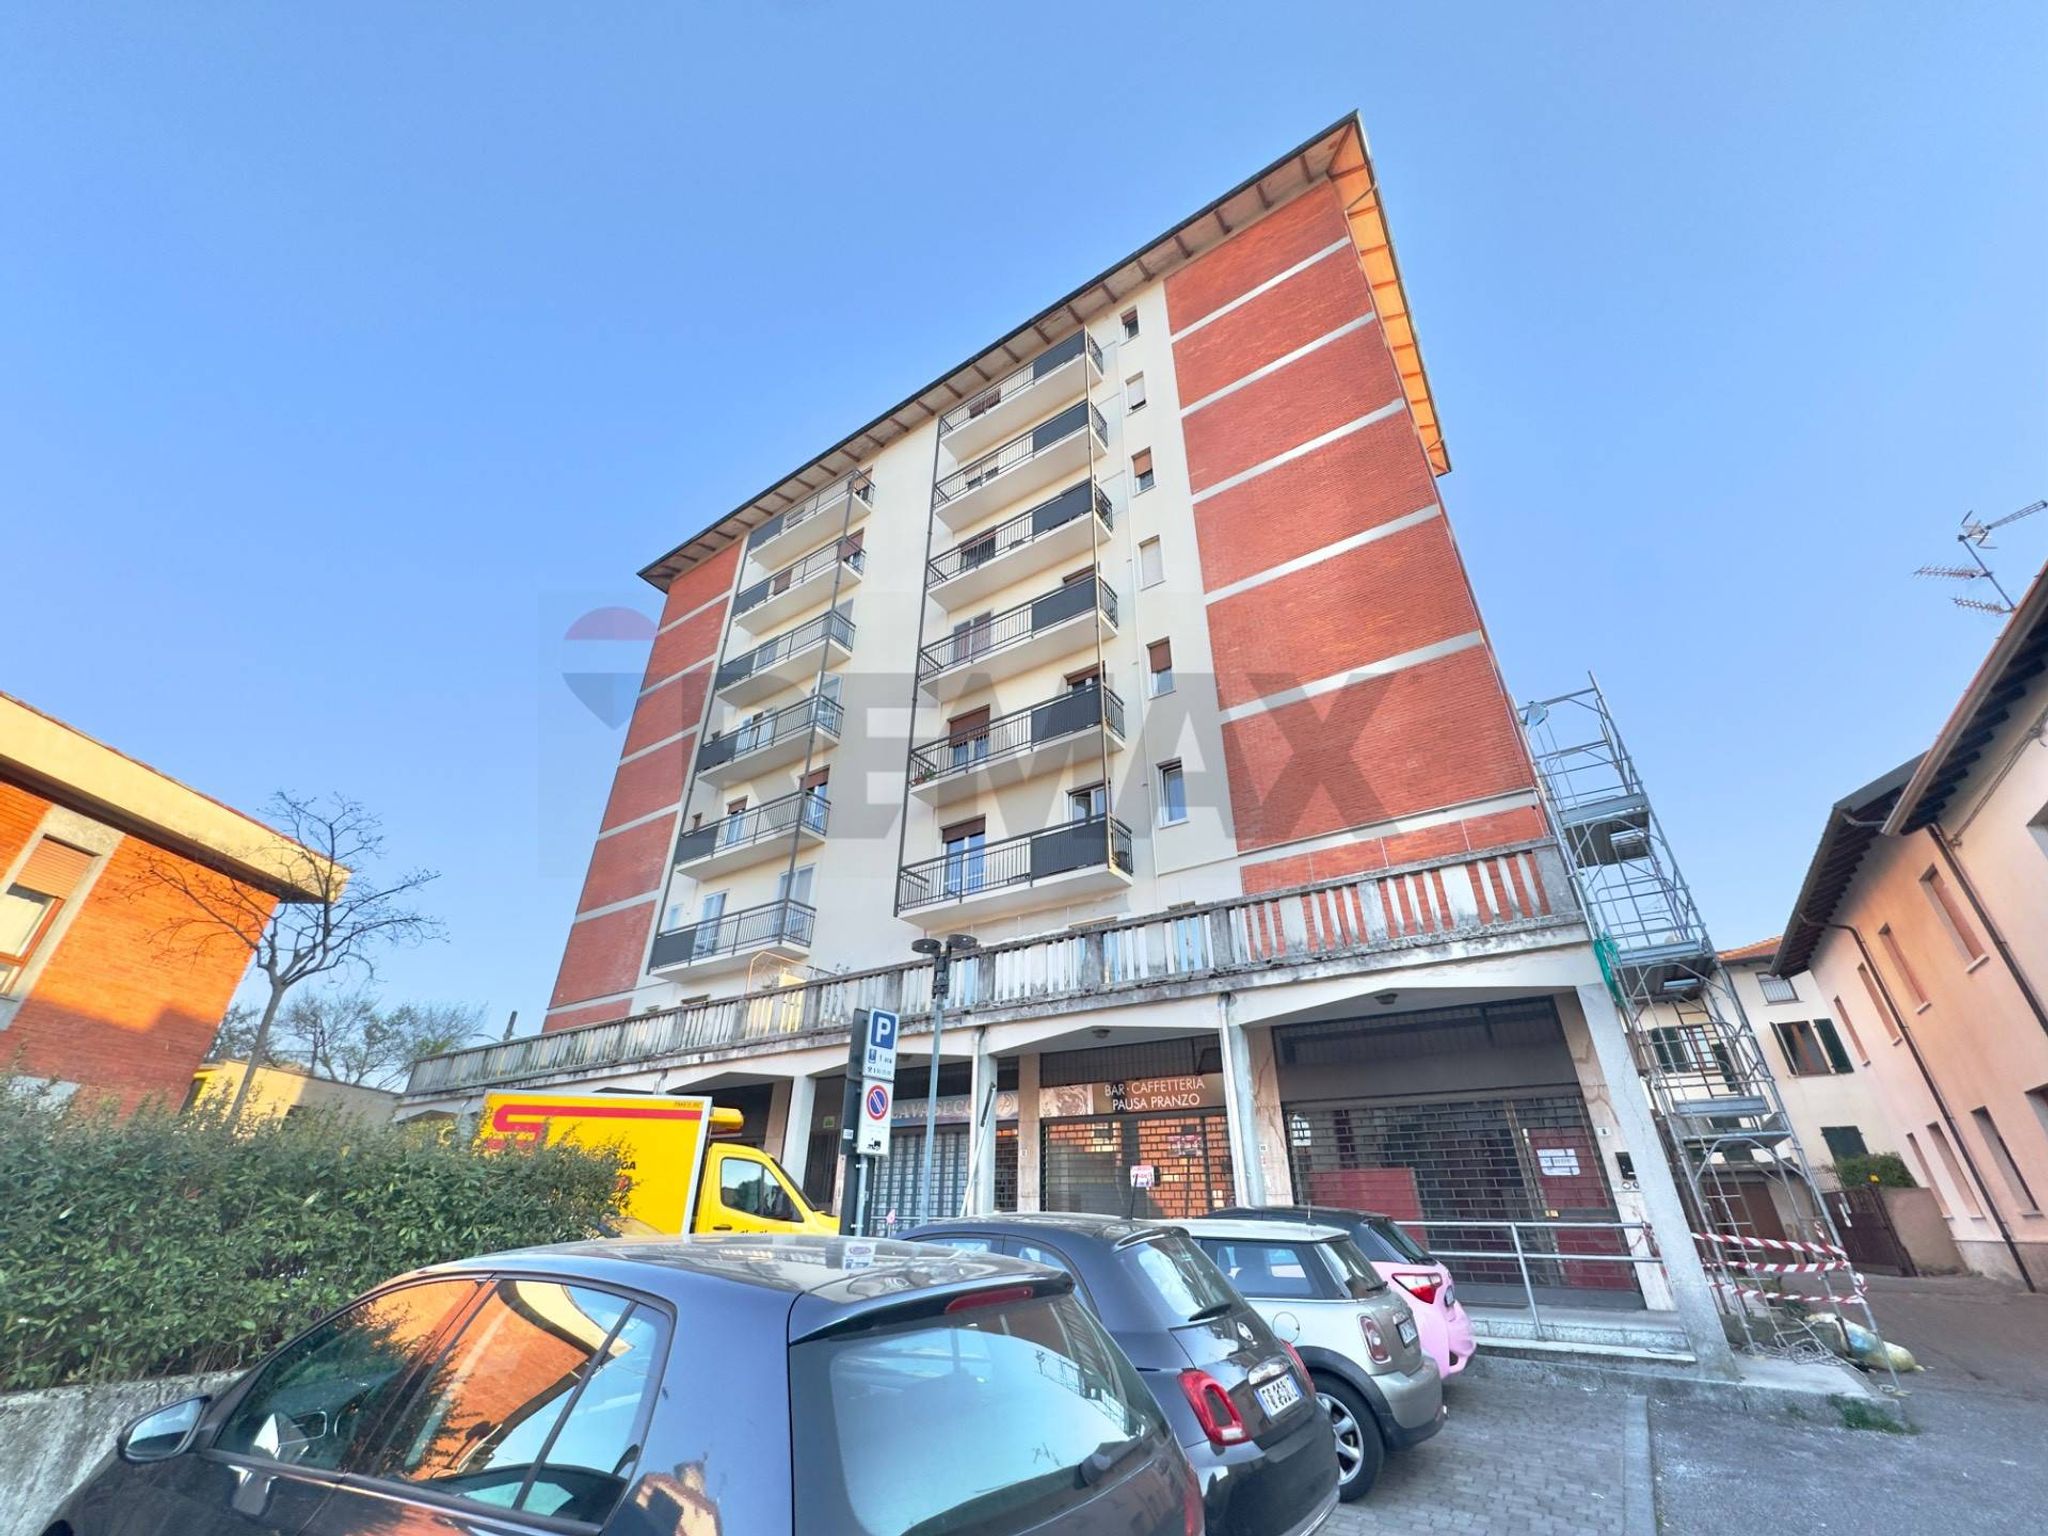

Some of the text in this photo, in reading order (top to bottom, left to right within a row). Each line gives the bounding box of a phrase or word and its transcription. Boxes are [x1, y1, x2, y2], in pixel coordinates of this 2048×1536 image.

[876, 1016, 891, 1043] P
[1104, 1077, 1206, 1097] BAR CAFFETTERIA
[1112, 1093, 1201, 1111] PAUSA PRANZO
